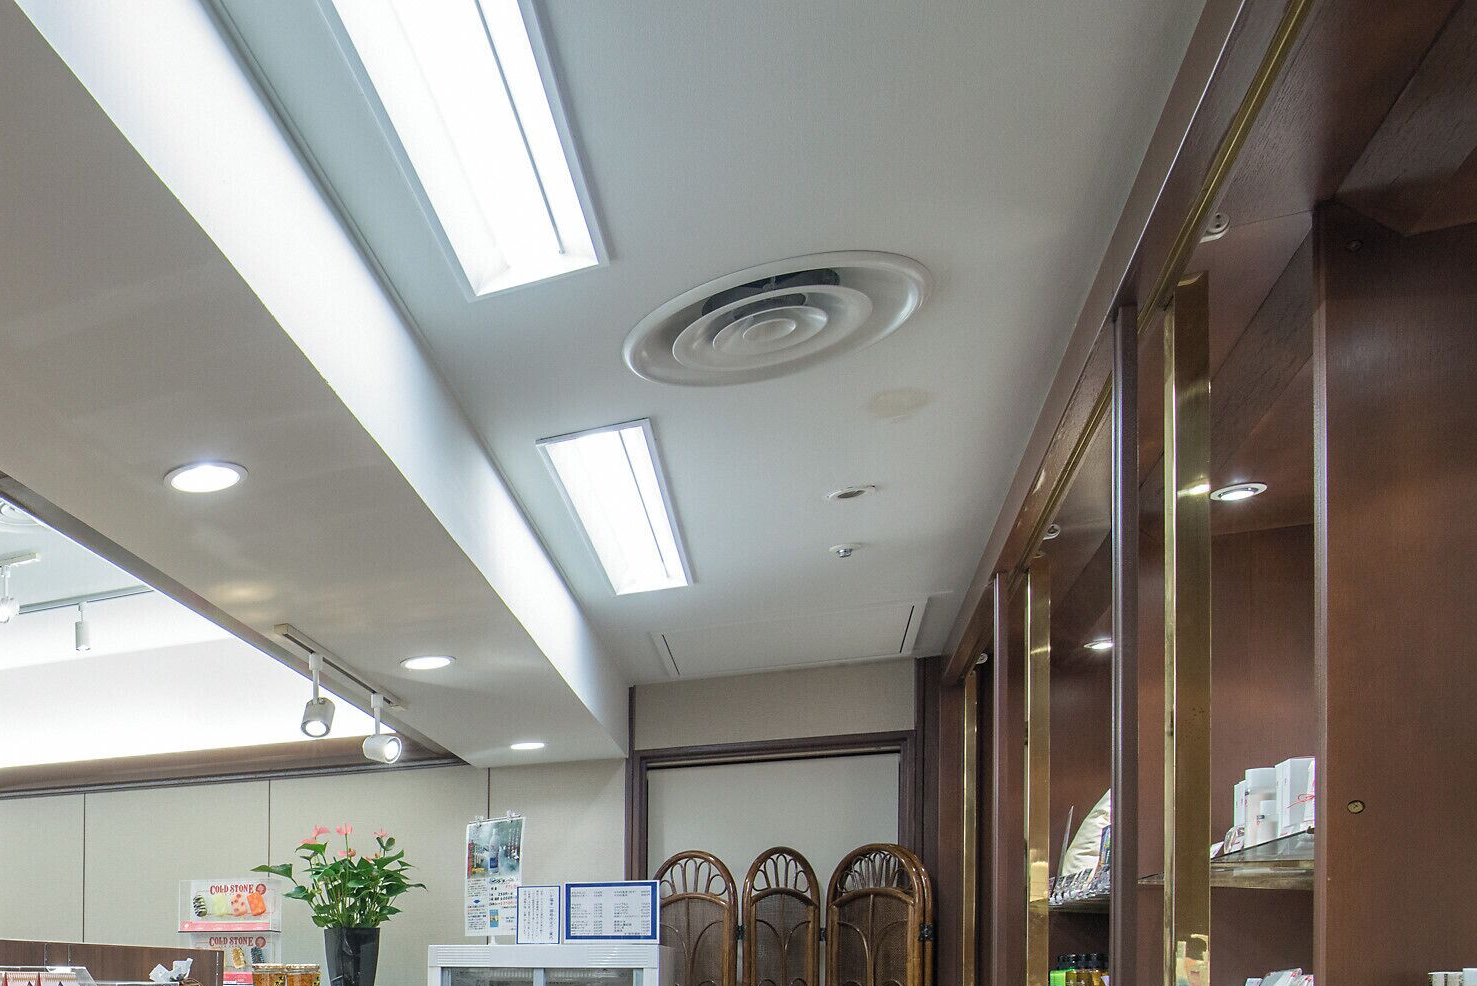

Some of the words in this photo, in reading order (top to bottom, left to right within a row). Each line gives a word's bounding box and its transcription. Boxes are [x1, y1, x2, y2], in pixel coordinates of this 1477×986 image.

[209, 885, 229, 895] COLD
[230, 884, 254, 893] STONE
[208, 936, 229, 947] COLD
[229, 936, 254, 946] STONE
